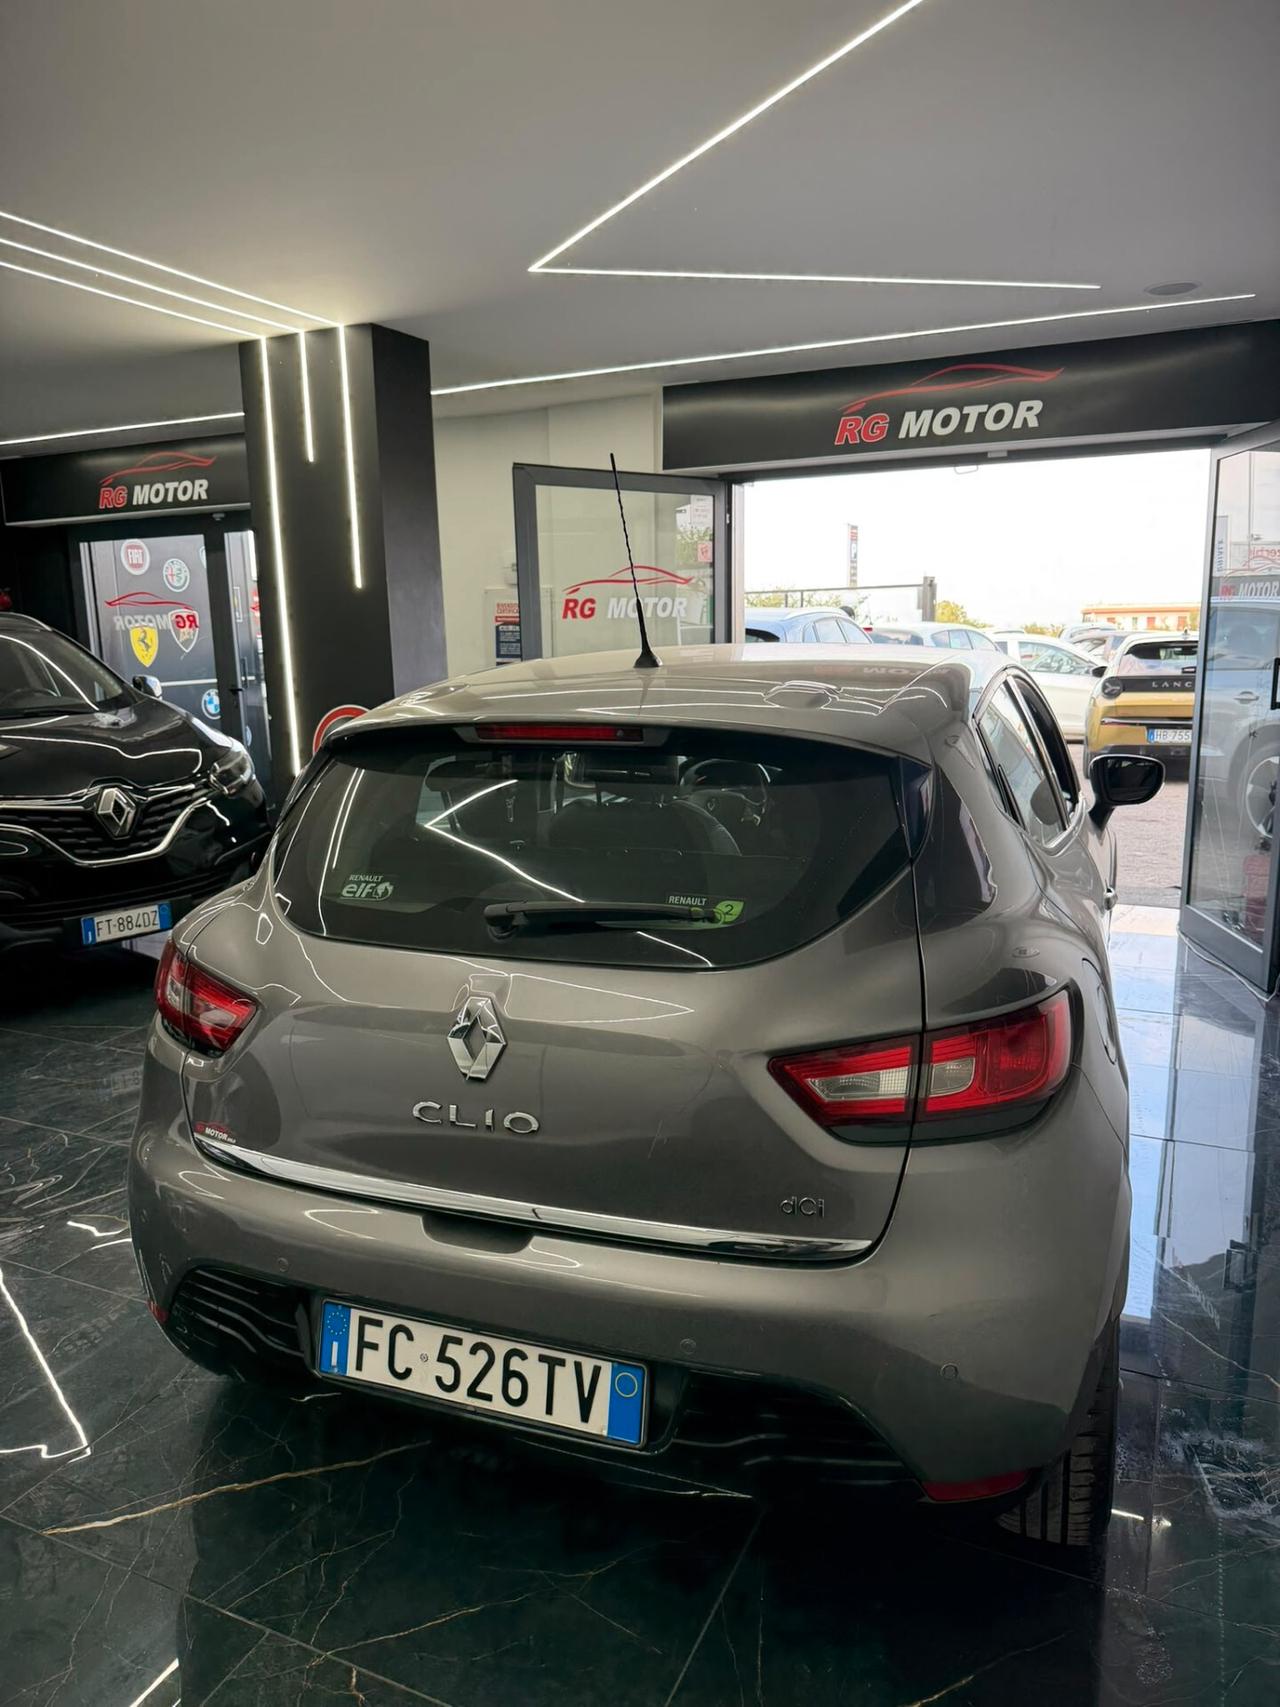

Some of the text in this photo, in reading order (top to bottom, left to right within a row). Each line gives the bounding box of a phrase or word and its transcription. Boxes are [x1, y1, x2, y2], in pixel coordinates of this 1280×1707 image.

[834, 400, 1044, 446] RG MOTOR
[99, 479, 209, 509] RG MOTOR
[562, 597, 688, 620] RG MOTOR
[349, 874, 384, 882] RENAULT
[341, 883, 376, 898] elf
[668, 895, 707, 906] RENAULT
[412, 1101, 540, 1135] CLIO
[780, 1196, 825, 1219] dCi
